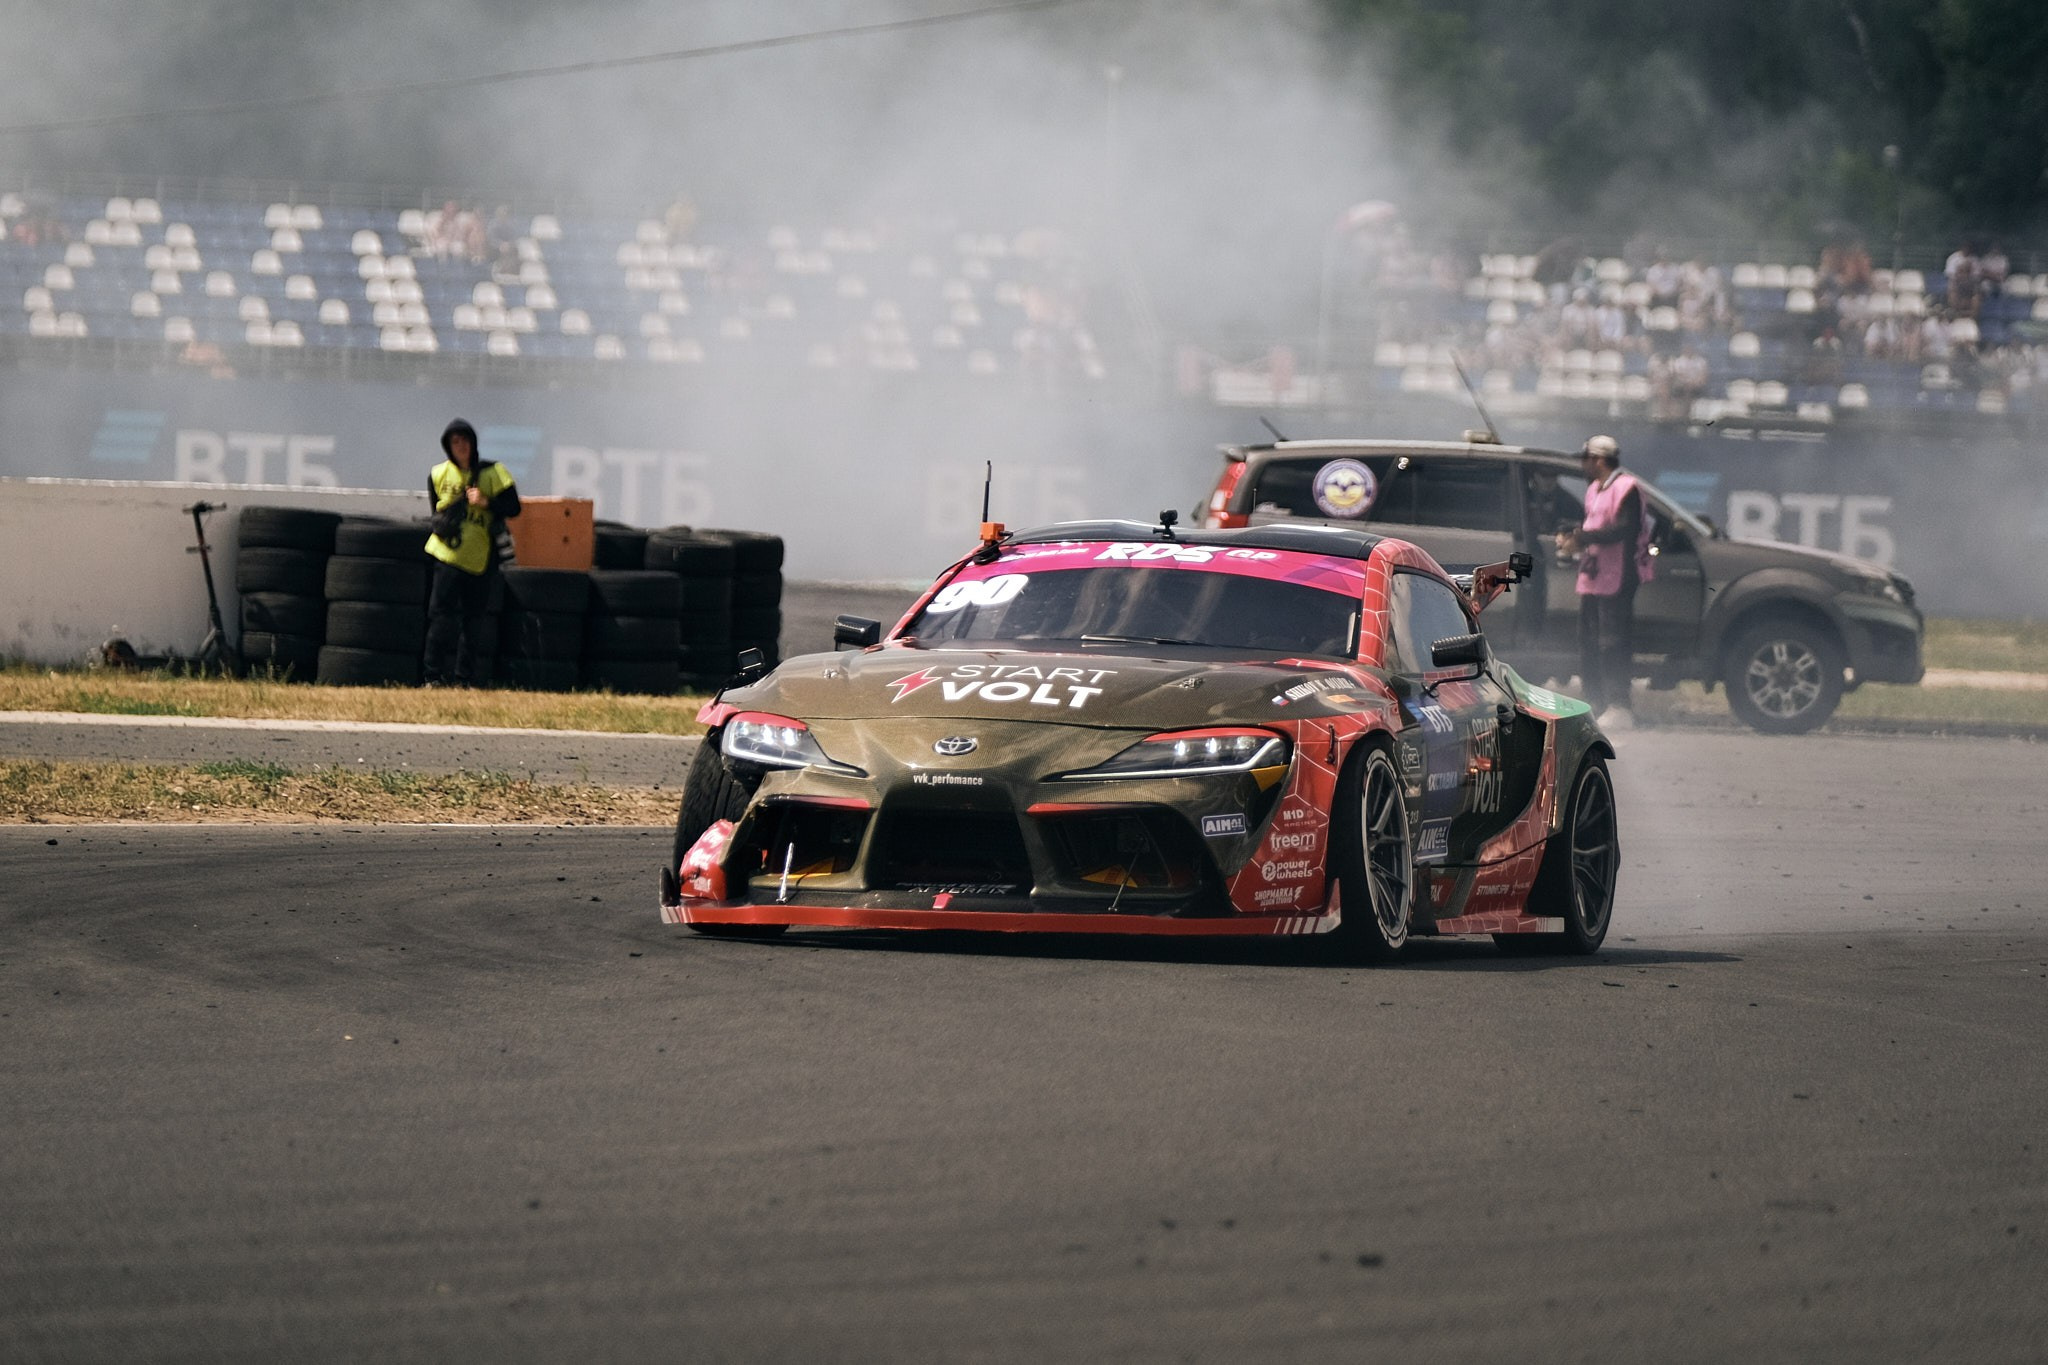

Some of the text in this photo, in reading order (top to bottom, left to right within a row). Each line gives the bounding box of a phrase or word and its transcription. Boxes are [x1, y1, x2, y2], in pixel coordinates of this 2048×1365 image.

[175, 429, 340, 486] ВТБ
[551, 446, 714, 523] ВТБ
[1726, 490, 1895, 568] ВТБ
[1093, 542, 1229, 563] RDS
[1225, 549, 1278, 561] GP
[926, 573, 1030, 614] 90
[950, 664, 1118, 684] START
[941, 681, 1104, 708] VOLT
[1420, 704, 1454, 733] ВТБ
[1471, 717, 1501, 758] START
[912, 772, 983, 786] vvk_perfomance
[1472, 771, 1503, 813] VOLT
[1283, 809, 1304, 820] M1D
[1270, 833, 1315, 849] freem
[1276, 860, 1311, 870] power
[1276, 868, 1313, 880] wheels
